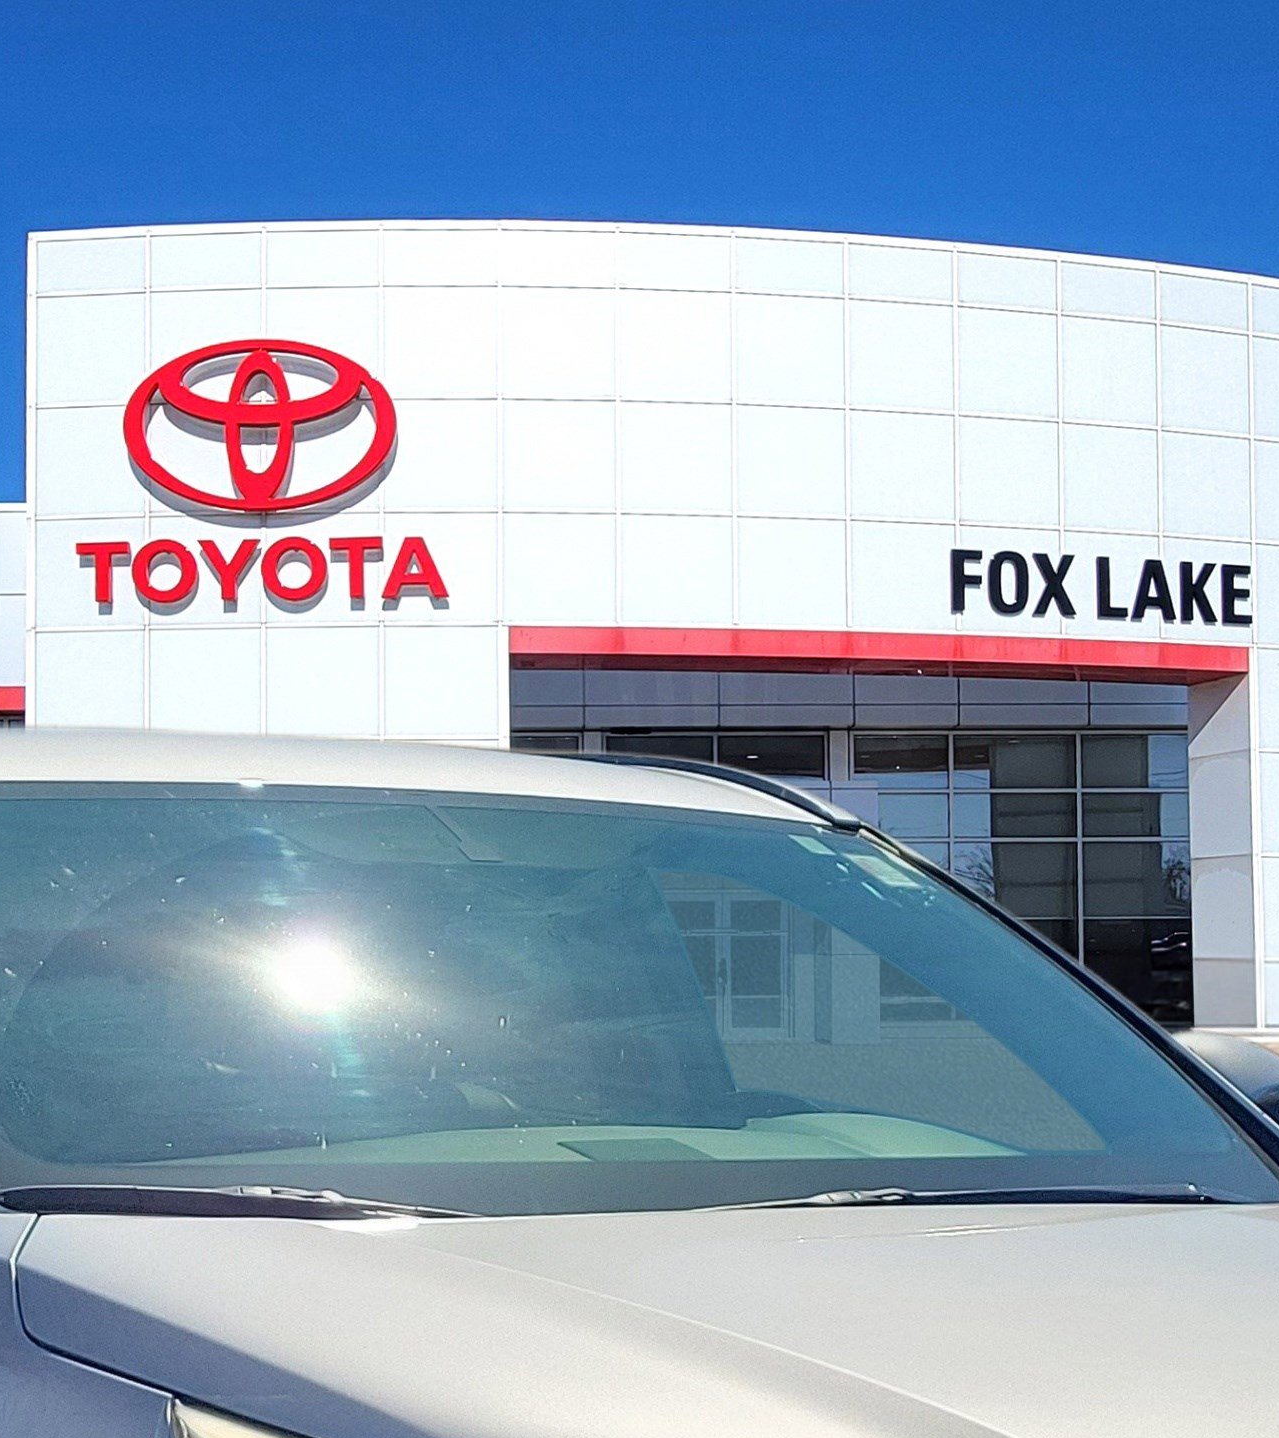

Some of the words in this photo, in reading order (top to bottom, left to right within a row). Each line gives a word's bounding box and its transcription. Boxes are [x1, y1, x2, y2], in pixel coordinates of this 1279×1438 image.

[76, 536, 448, 604] TOYOTA
[950, 548, 1077, 617] FOX
[1096, 556, 1253, 625] LAKE
